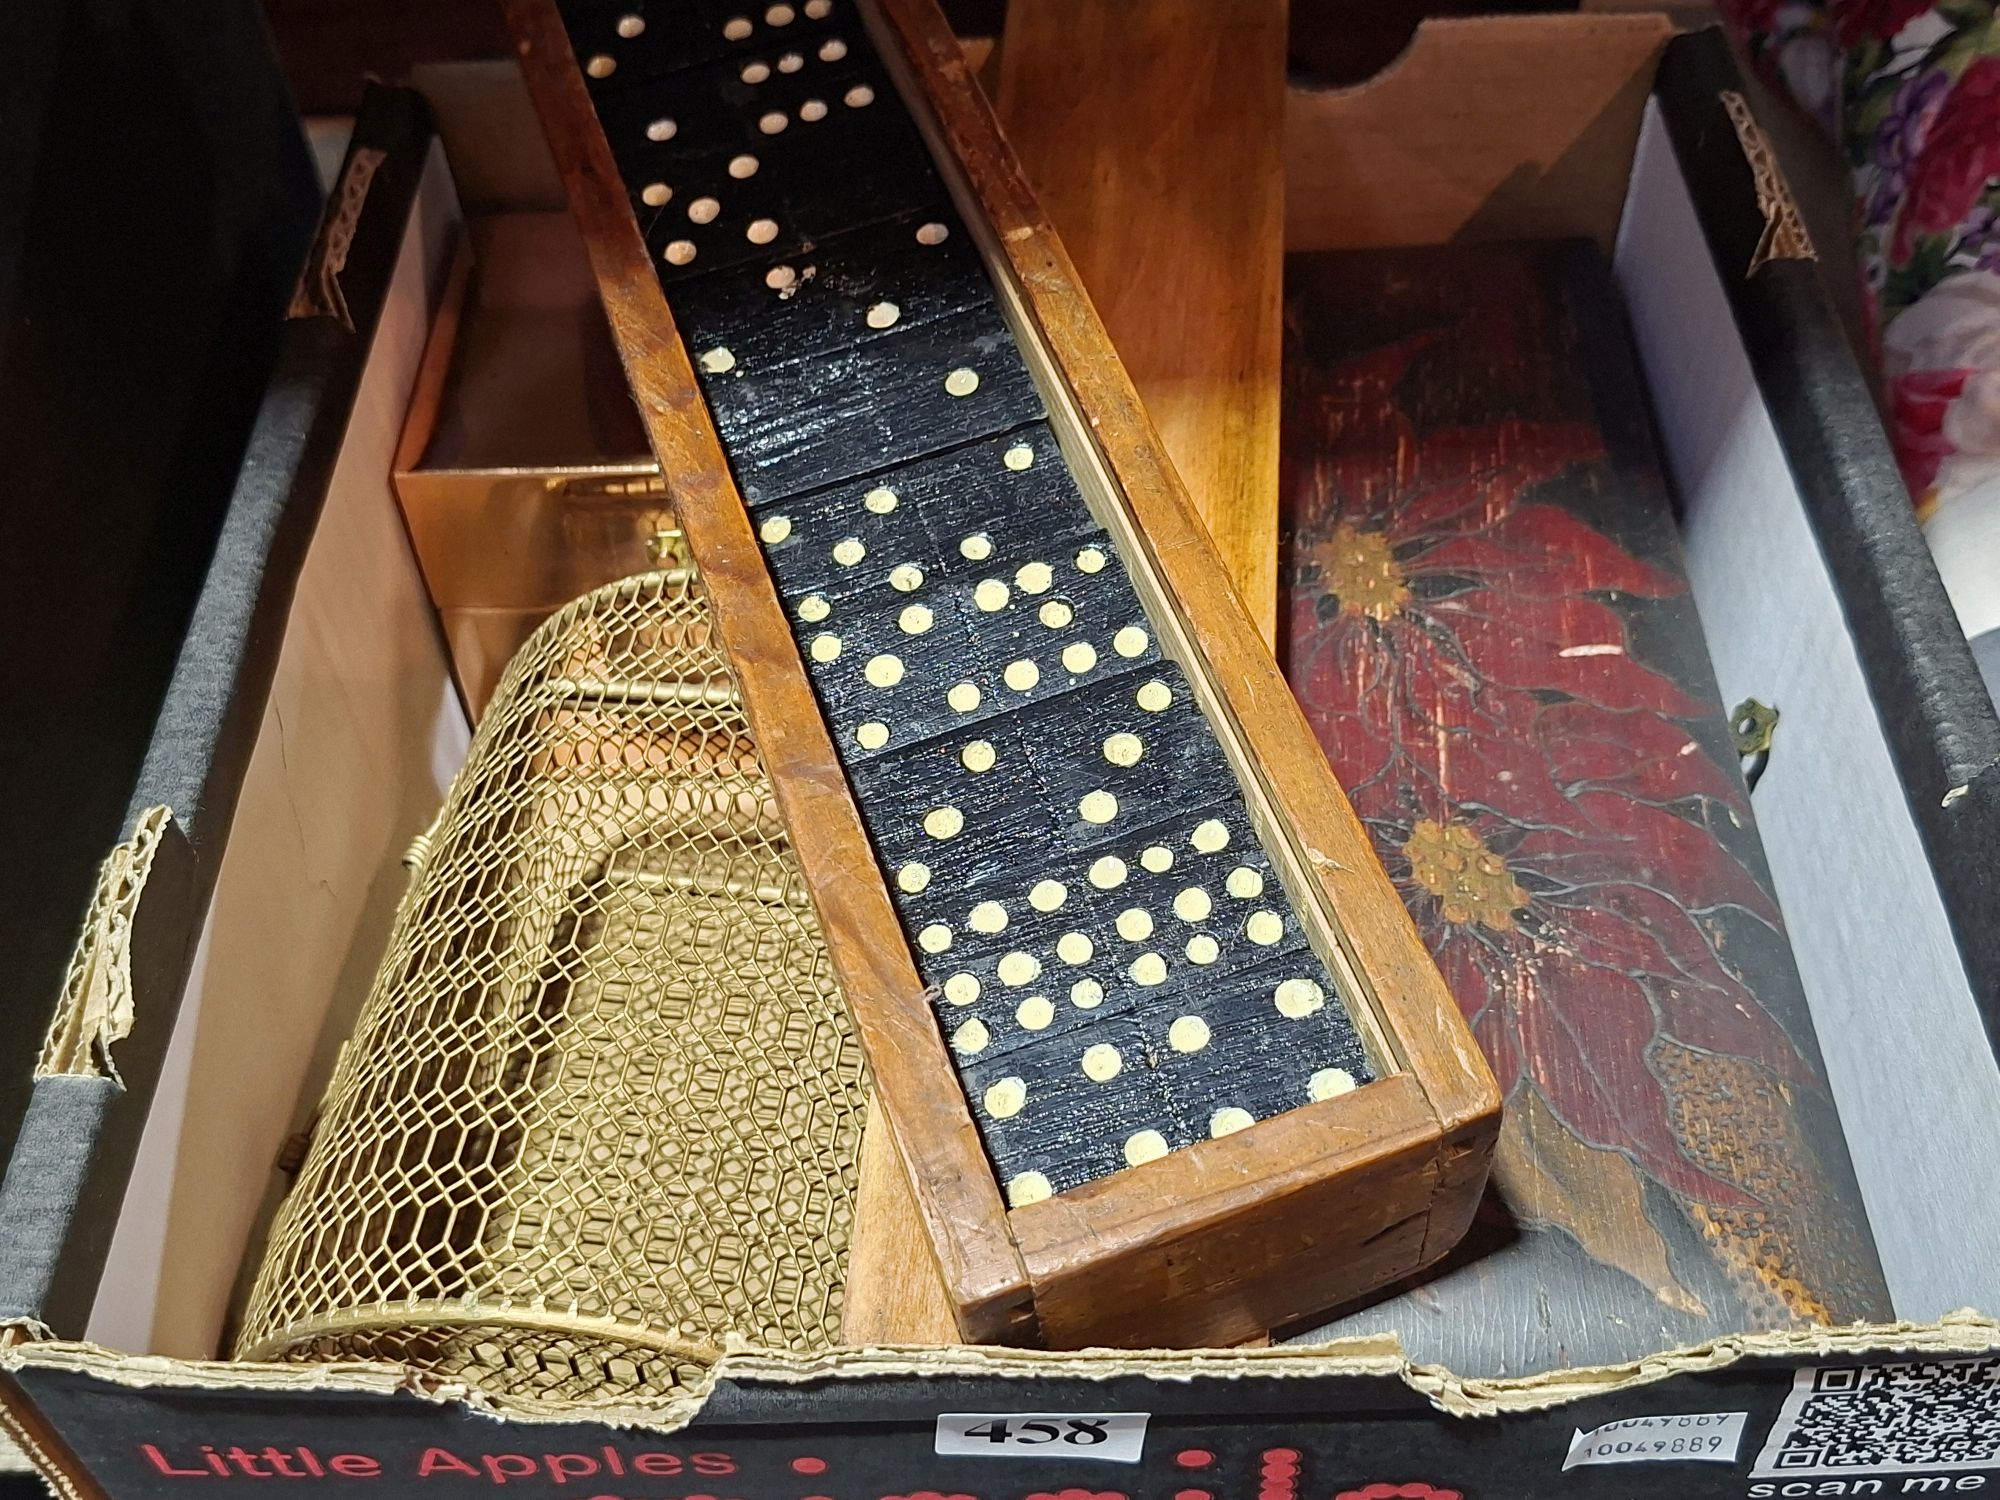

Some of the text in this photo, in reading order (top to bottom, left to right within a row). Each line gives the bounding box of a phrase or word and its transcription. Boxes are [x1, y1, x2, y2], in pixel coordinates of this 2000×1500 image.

[964, 1417, 1110, 1446] 458
[1583, 1436, 1723, 1459] 10049889
[142, 1444, 382, 1477] Little
[417, 1446, 738, 1484] Apples
[1746, 1474, 1986, 1499] scan me
